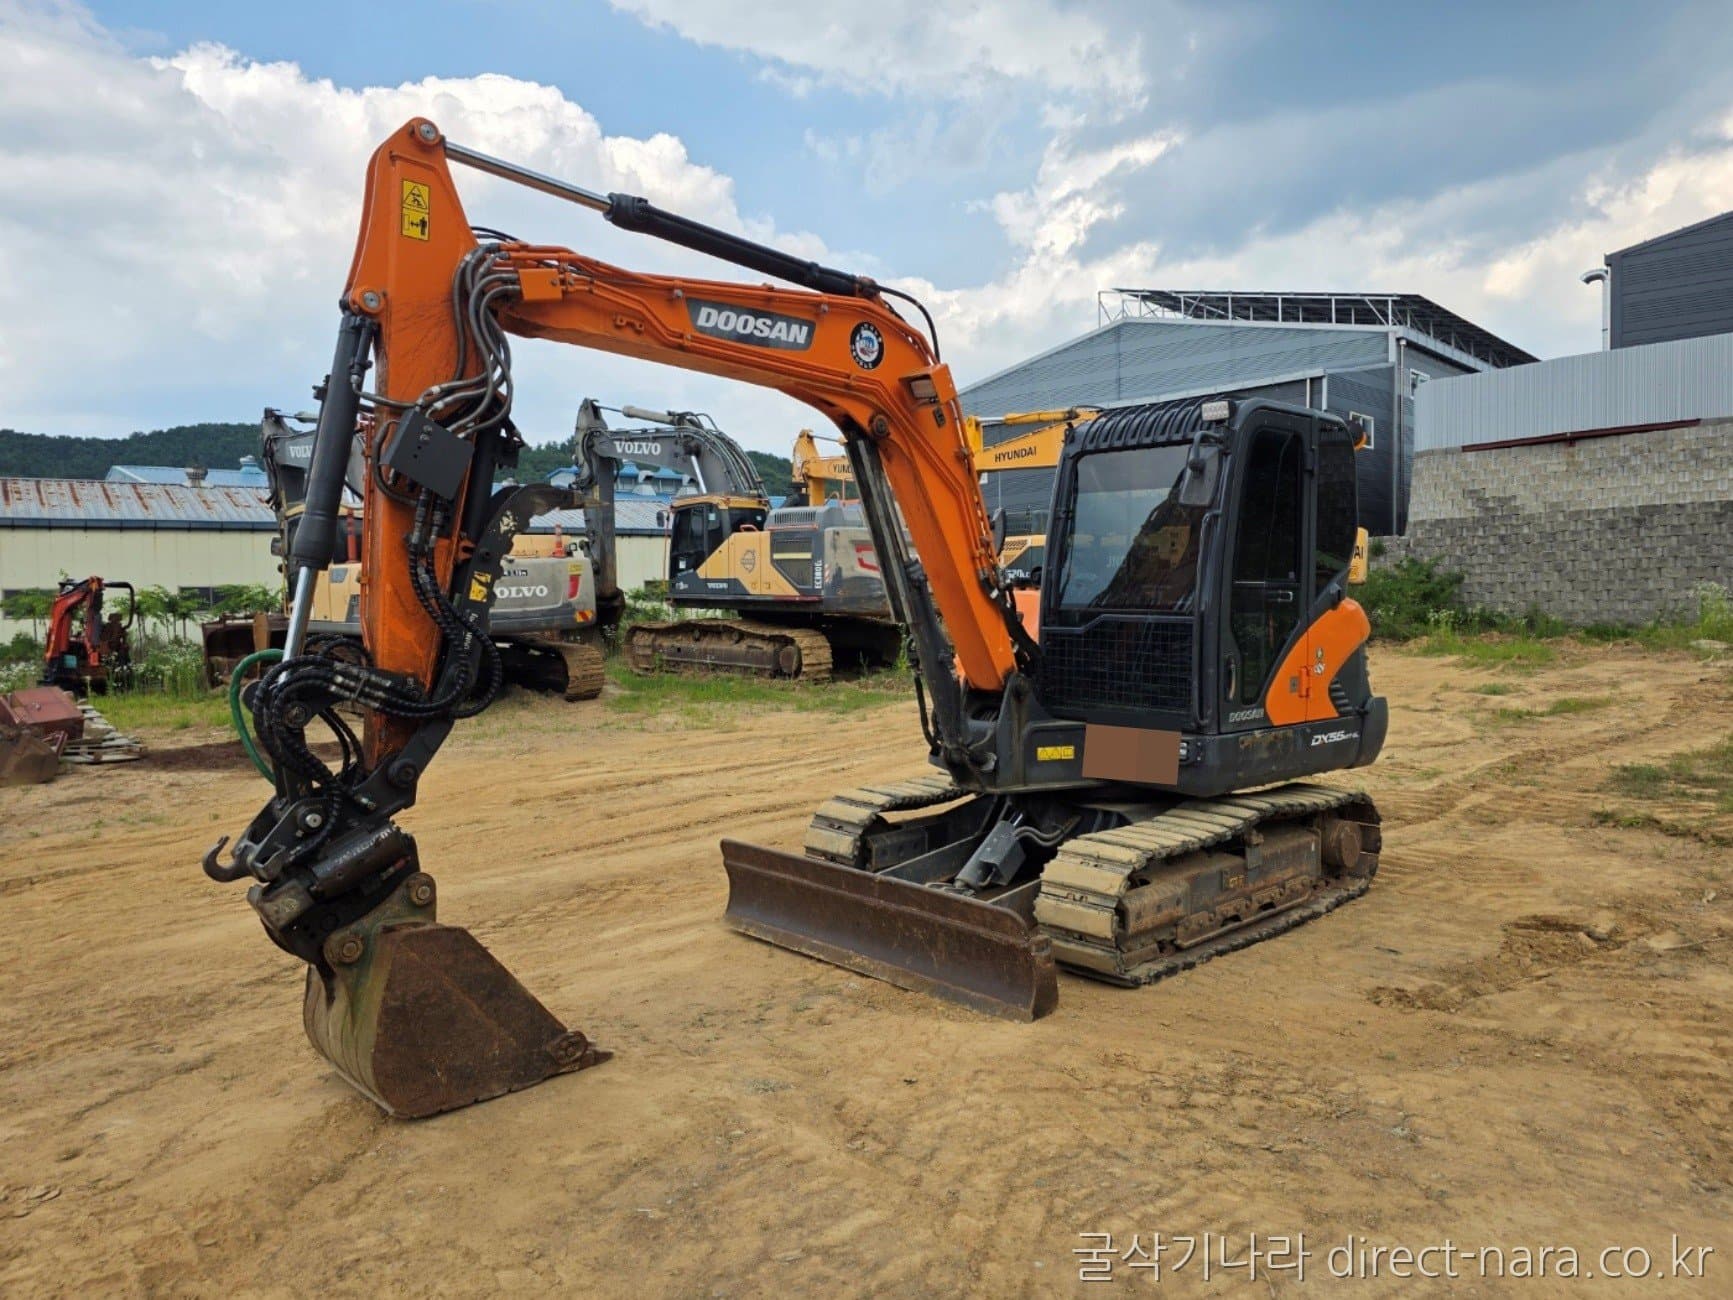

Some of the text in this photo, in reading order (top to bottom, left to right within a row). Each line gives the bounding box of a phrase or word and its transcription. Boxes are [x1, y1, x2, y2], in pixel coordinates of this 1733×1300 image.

[697, 306, 809, 344] DOOSAN
[613, 441, 661, 456] VOLVO
[994, 446, 1037, 463] HYUNDAI
[1353, 545, 1364, 560] AI
[494, 585, 548, 599] OLVO
